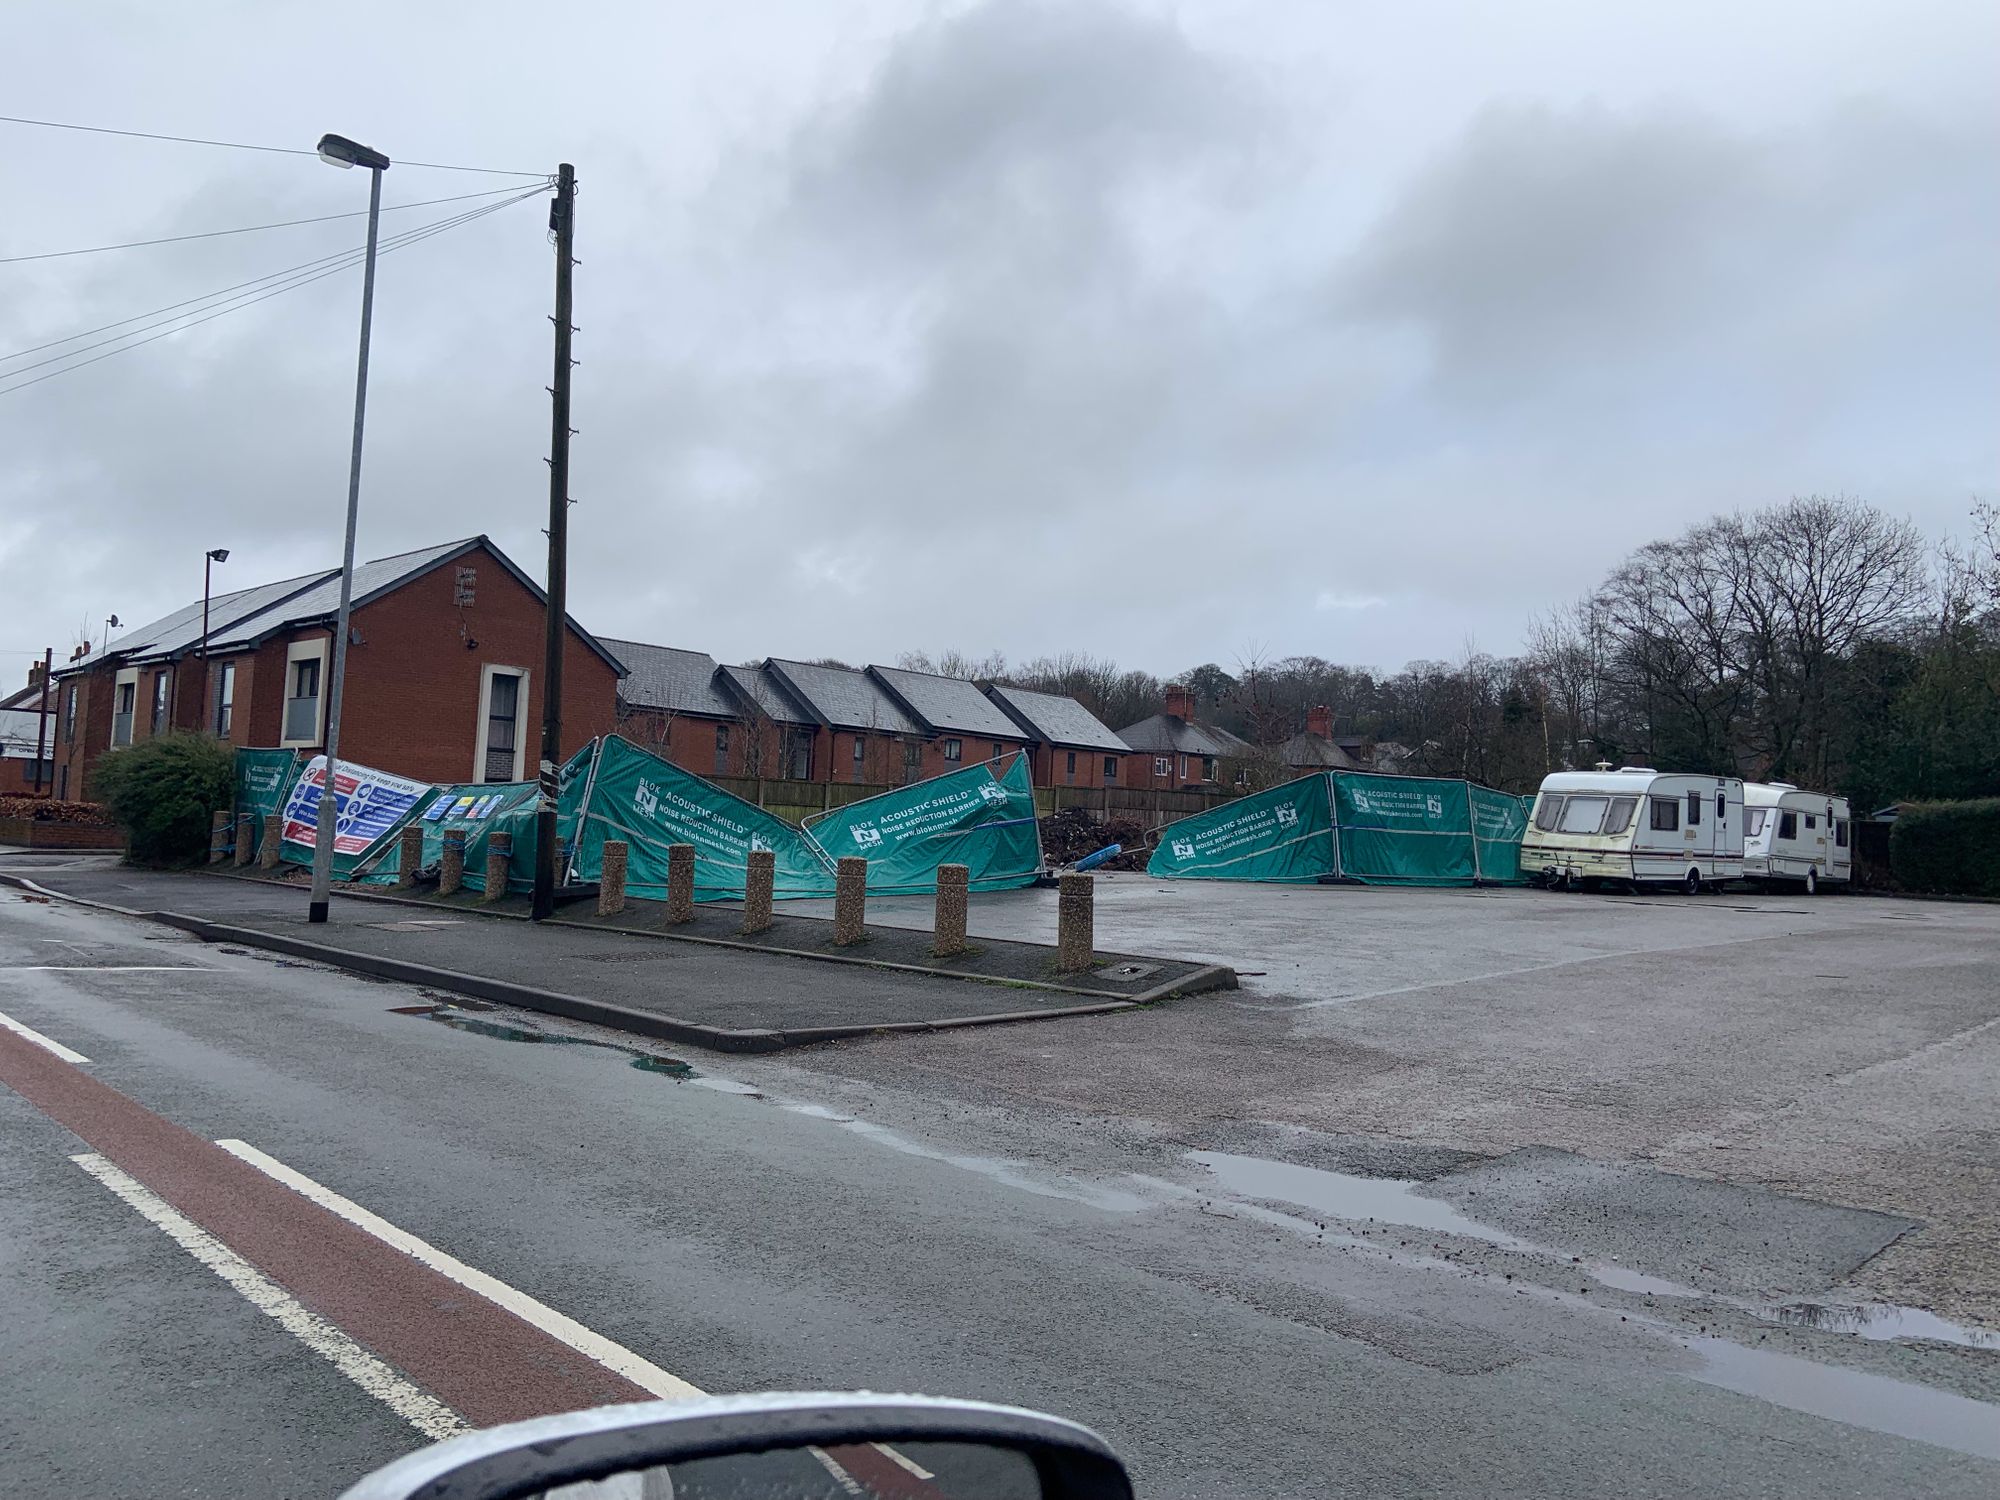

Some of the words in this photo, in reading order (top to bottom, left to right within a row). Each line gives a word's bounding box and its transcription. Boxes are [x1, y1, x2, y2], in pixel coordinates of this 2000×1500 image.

[640, 777, 661, 794] BLOK
[978, 781, 995, 792] BLO
[1367, 790, 1398, 799] ACOUSTIC
[633, 803, 655, 820] MESH
[665, 791, 712, 819] ACOUSTIC
[880, 801, 931, 825] ACOUSTIC
[1274, 800, 1295, 812] BLOK
[881, 823, 905, 835] NOISE
[905, 810, 948, 828] REDUCTION
[948, 797, 981, 815] BARRIER
[659, 803, 680, 820] NOISE
[680, 813, 720, 837] REDUCTION
[719, 831, 749, 850] BARRIER
[849, 820, 875, 831] BLOK
[1195, 821, 1236, 841] ACOUSTIC
[1280, 819, 1299, 831] MESH
[664, 820, 742, 856] www.bloknmesh.com
[752, 831, 772, 846] BLOK
[1171, 836, 1191, 847] BLOK
[1195, 841, 1214, 851] NOISE
[1214, 828, 1249, 845] REDUCTION
[1249, 818, 1276, 831] BARRIER
[1205, 829, 1273, 857] www.bloknmesh.com
[859, 839, 885, 851] MESH
